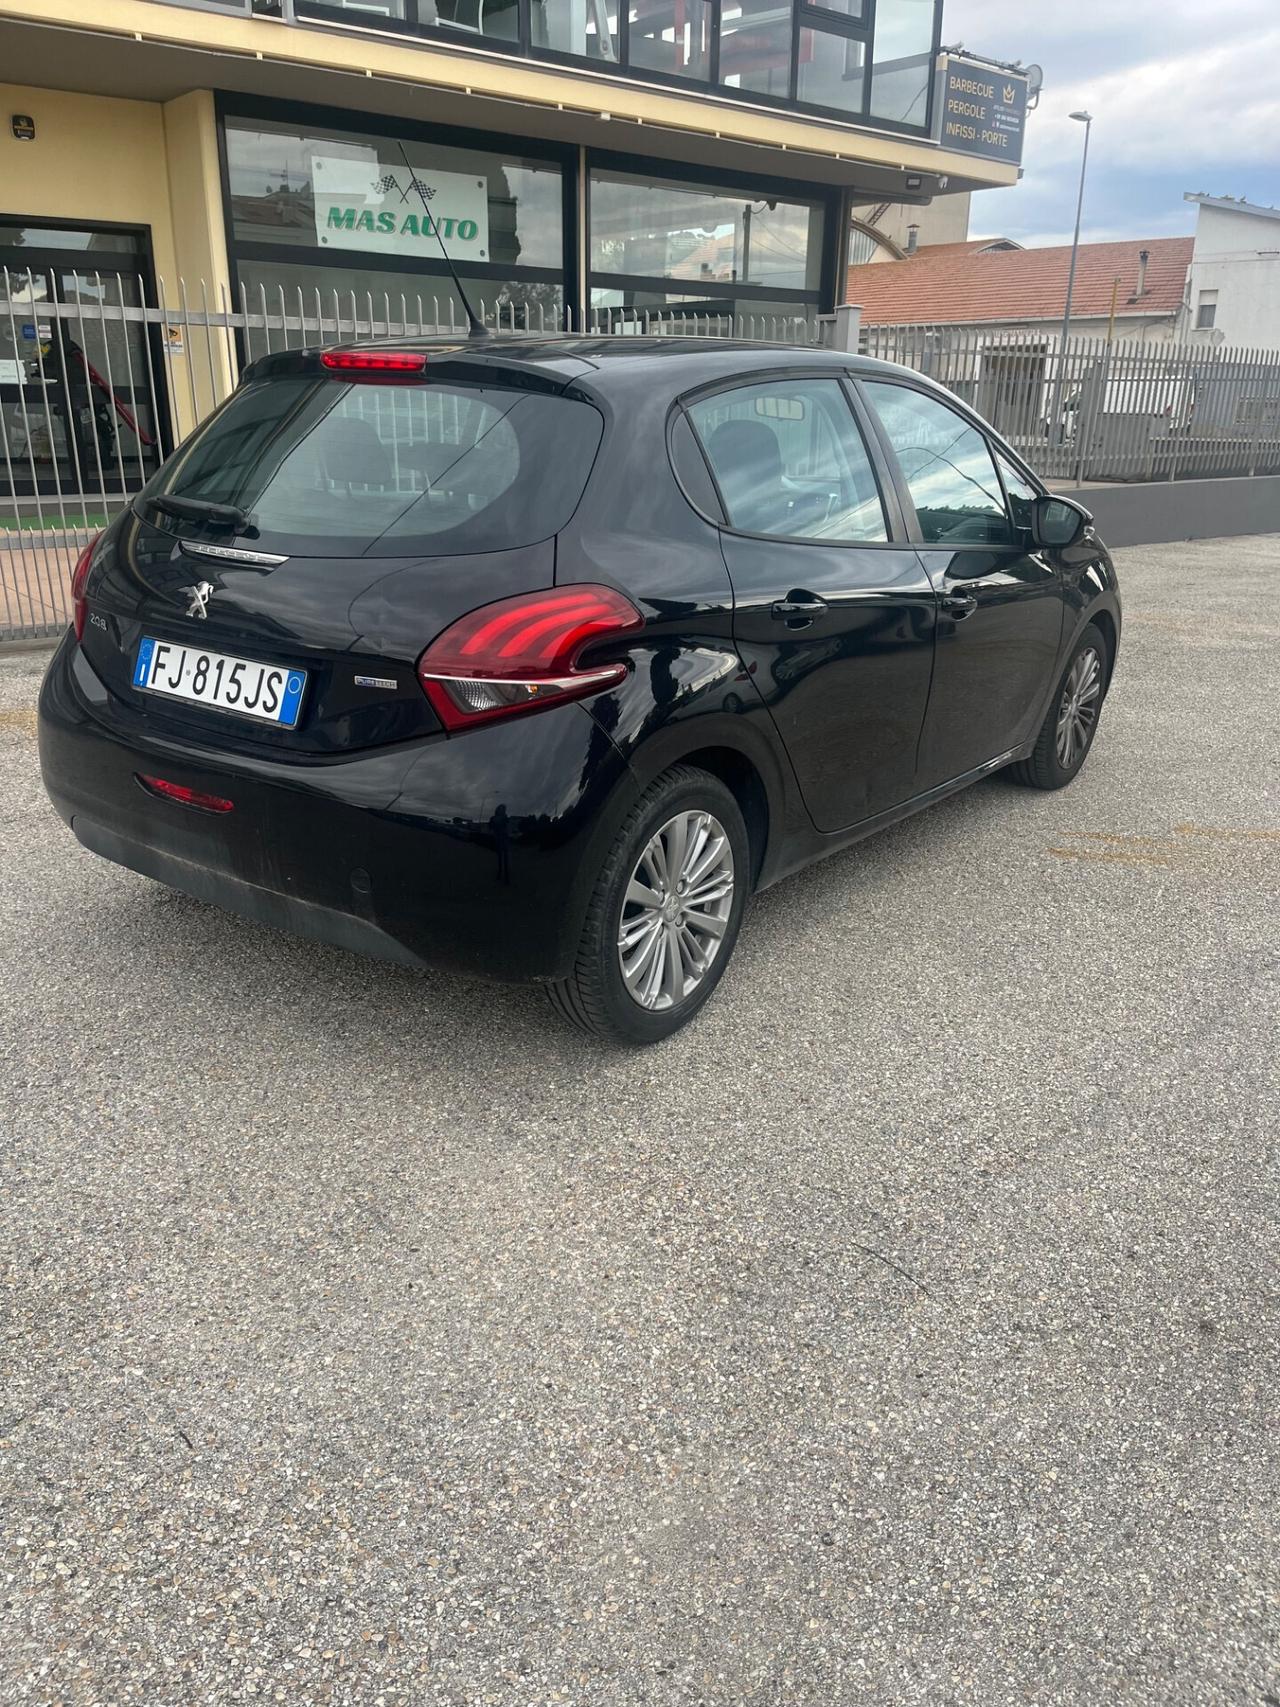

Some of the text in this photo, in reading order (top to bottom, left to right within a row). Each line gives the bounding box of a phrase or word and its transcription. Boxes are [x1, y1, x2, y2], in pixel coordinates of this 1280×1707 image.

[950, 76, 994, 98] BARBECUE
[948, 99, 986, 119] PERGOLE
[946, 121, 976, 140] INFISSI
[981, 130, 1009, 147] PORTE
[327, 206, 480, 241] MAS AUTO
[90, 612, 106, 630] 208
